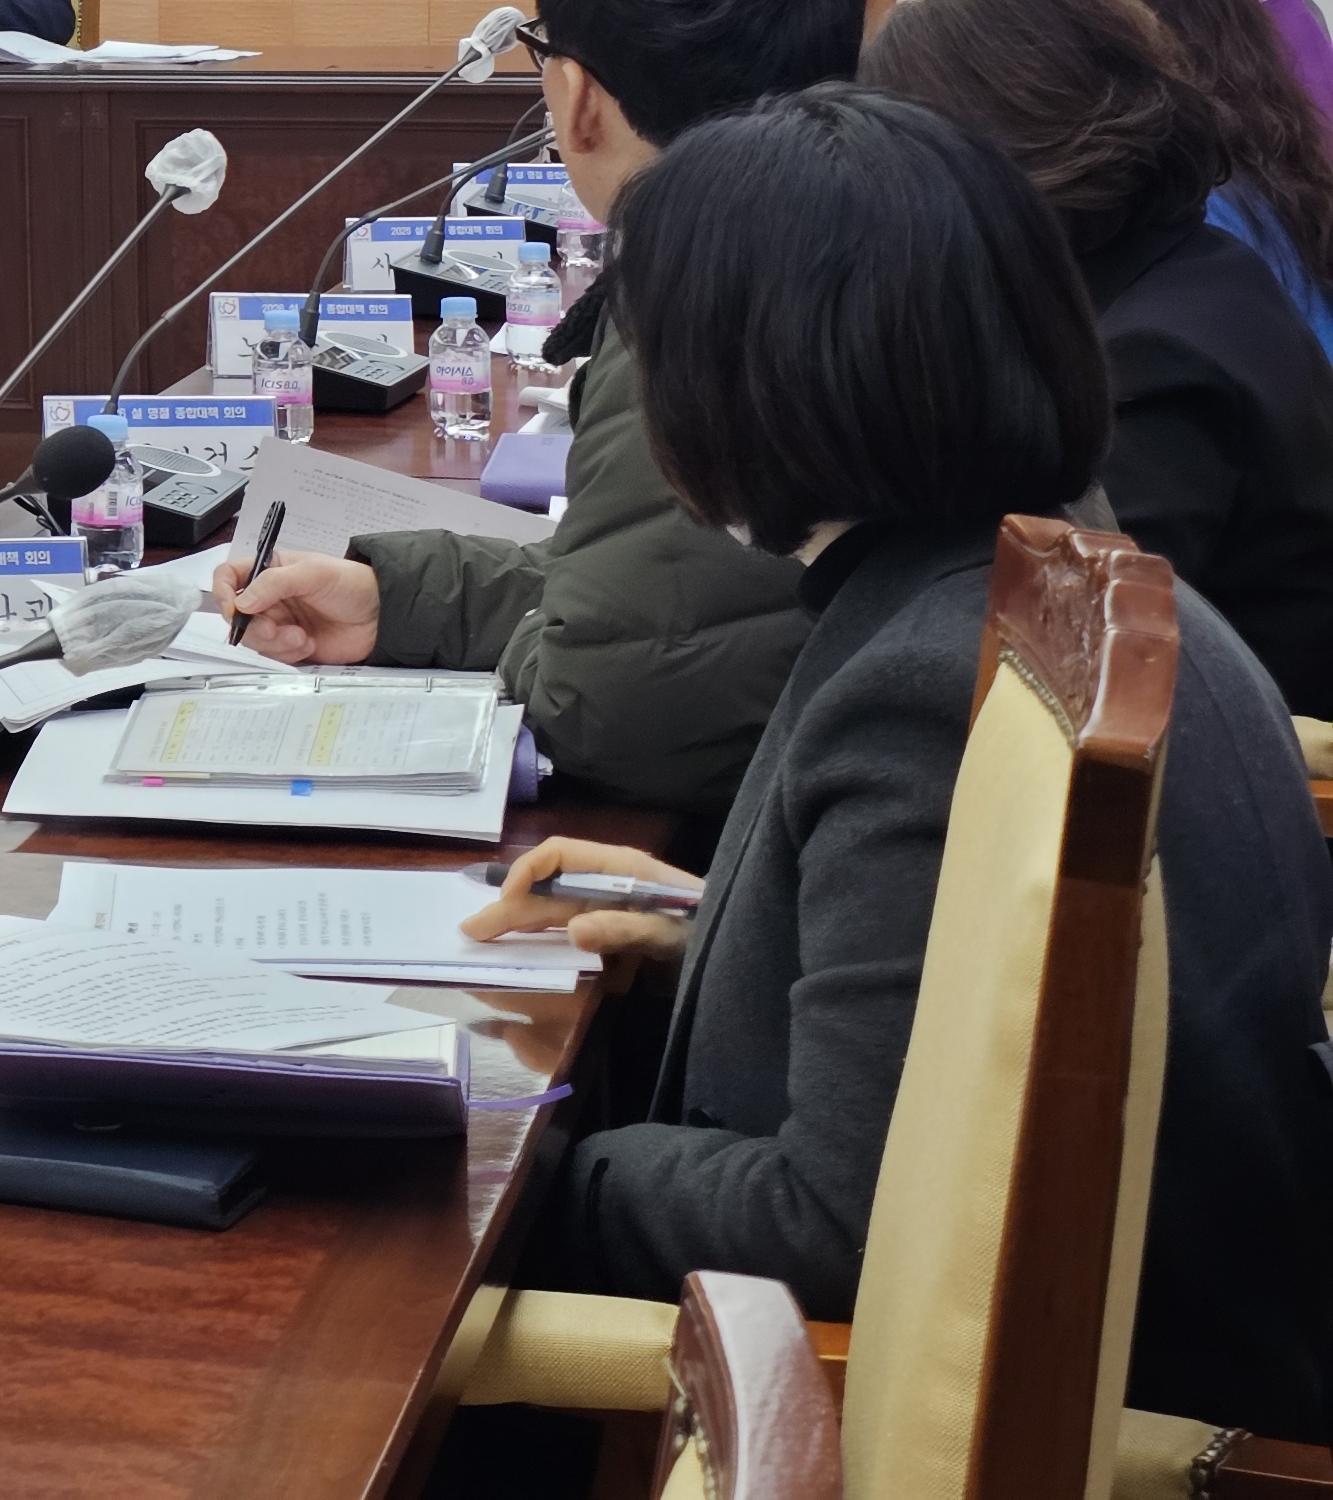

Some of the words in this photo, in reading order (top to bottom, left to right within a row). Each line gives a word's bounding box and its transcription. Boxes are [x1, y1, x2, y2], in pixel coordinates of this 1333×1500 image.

[327, 304, 365, 315] 종합대책
[369, 304, 389, 315] 회의
[436, 366, 474, 376] 아이시스
[131, 407, 143, 419] 설
[147, 407, 170, 420] 명절
[175, 406, 219, 420] 종합대책
[223, 406, 247, 419] 회의
[24, 550, 52, 565] 회의
